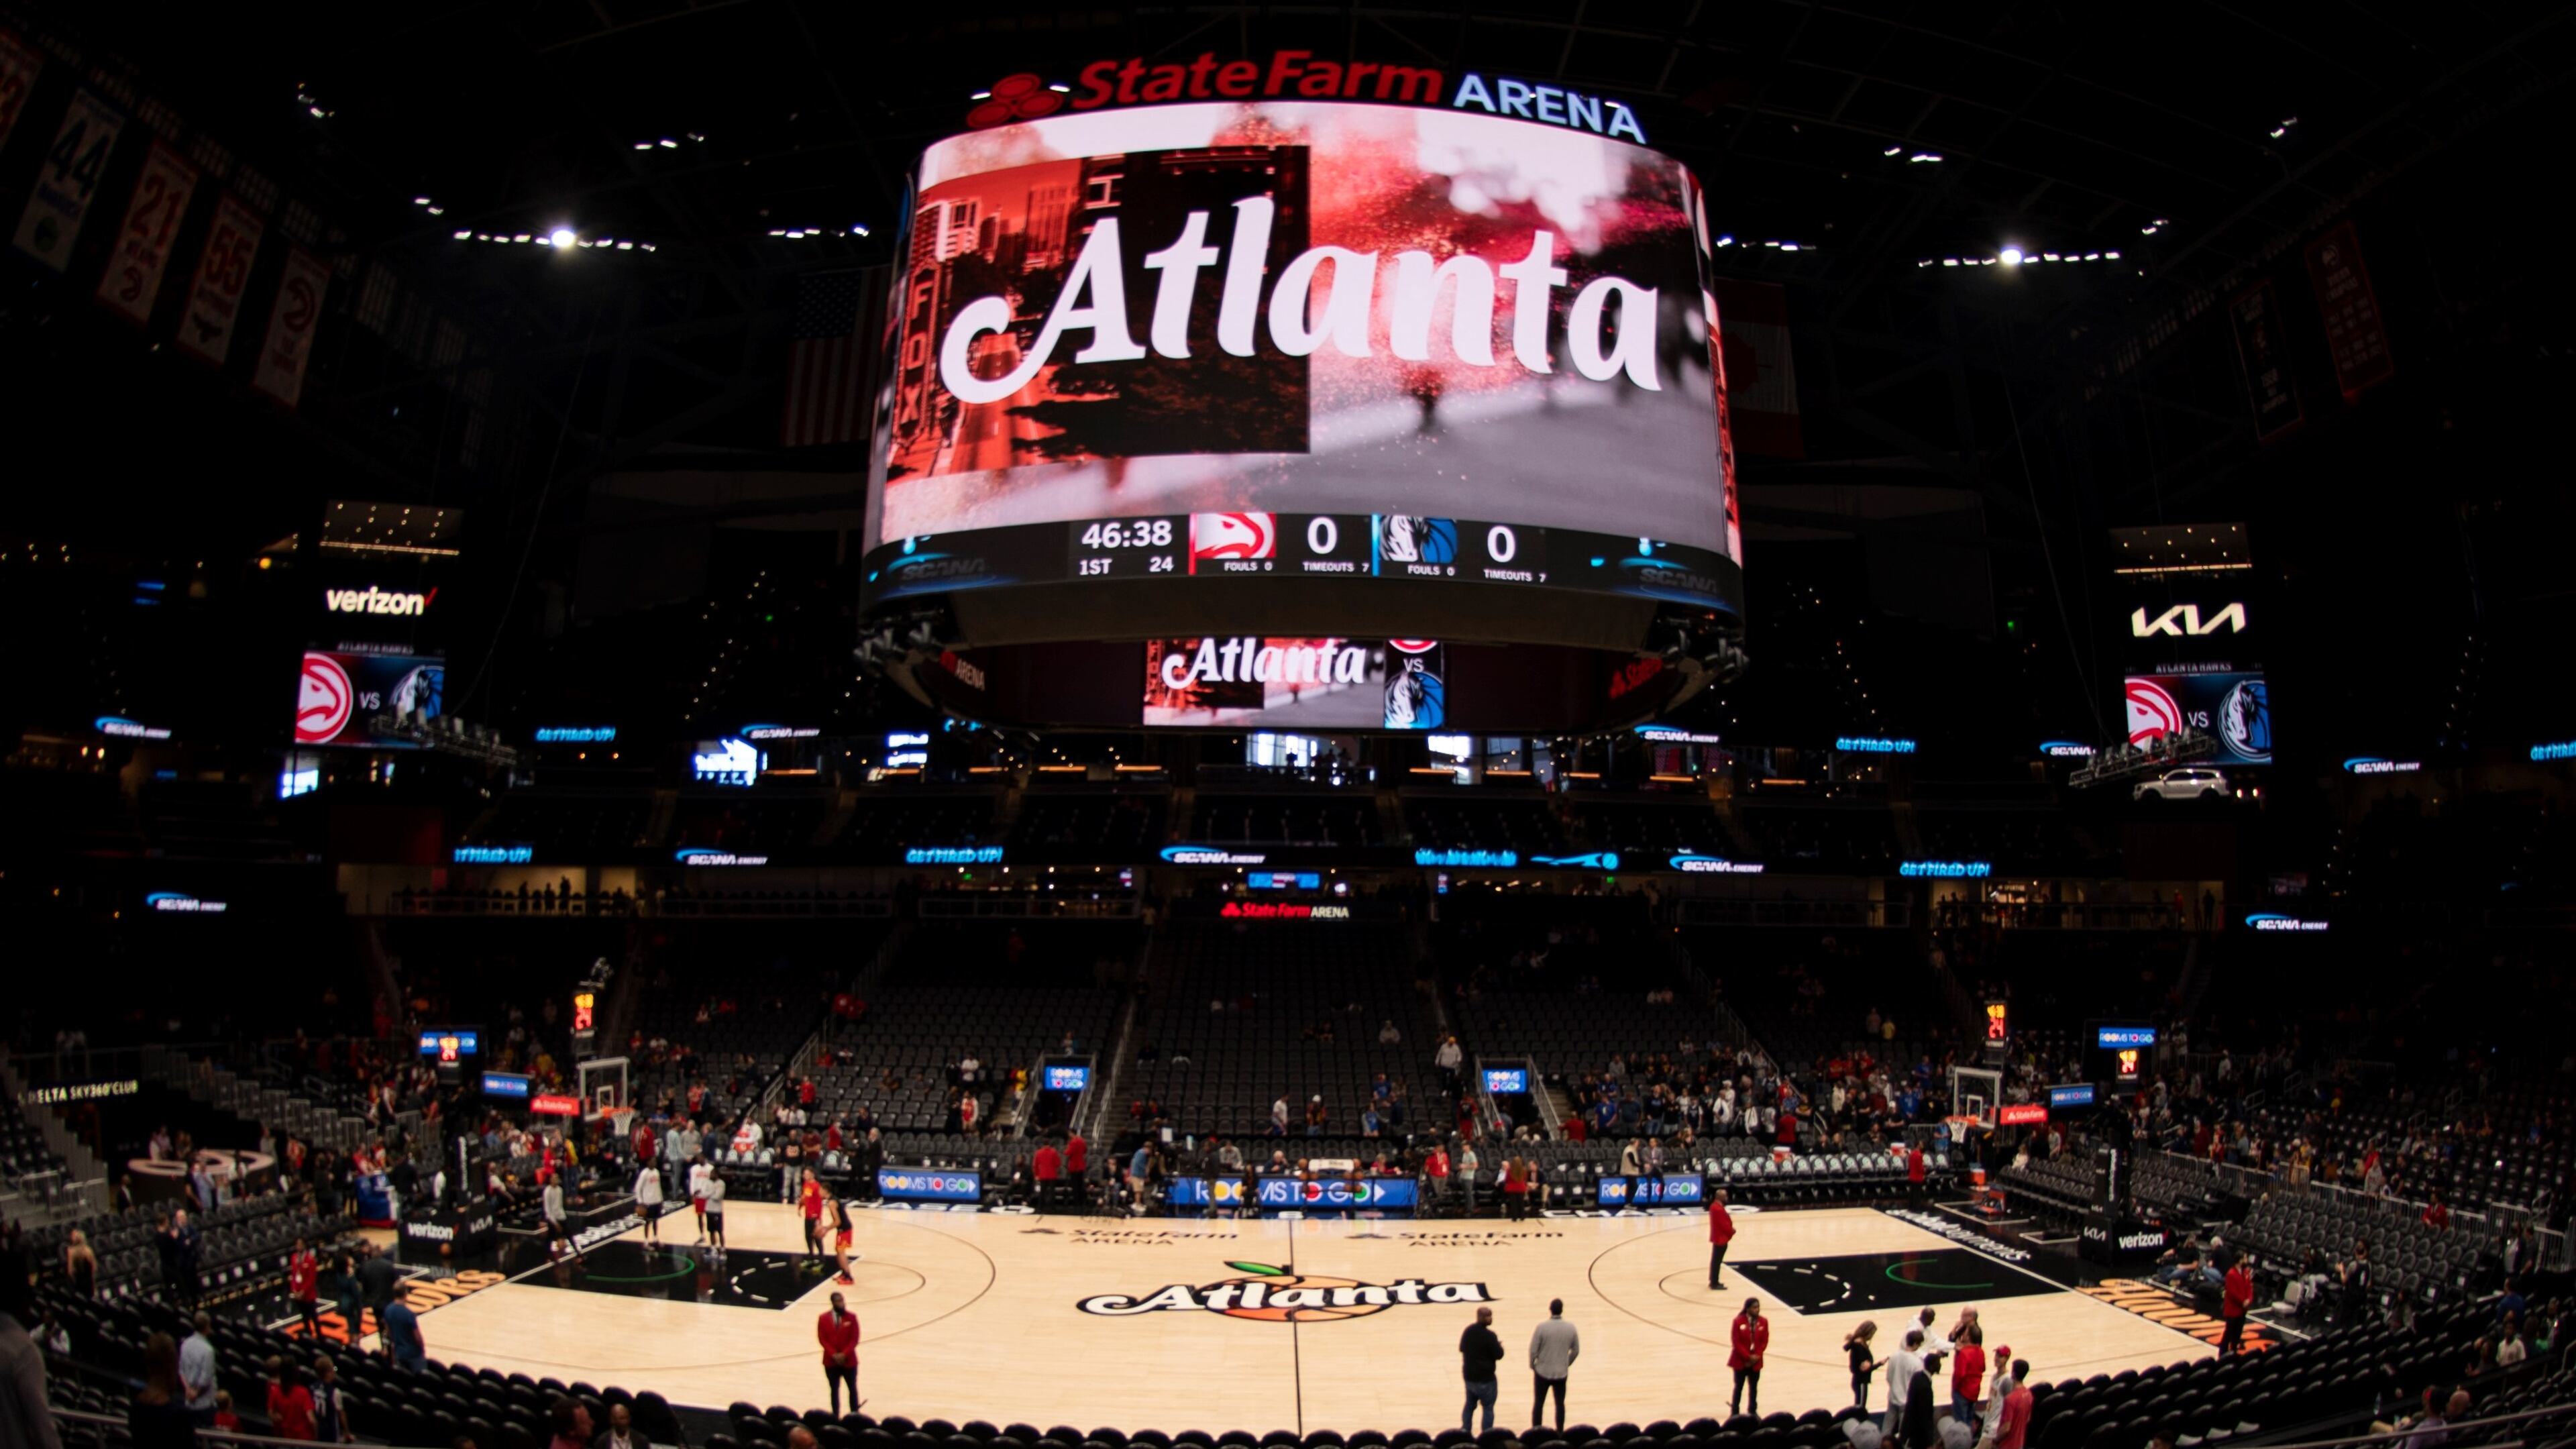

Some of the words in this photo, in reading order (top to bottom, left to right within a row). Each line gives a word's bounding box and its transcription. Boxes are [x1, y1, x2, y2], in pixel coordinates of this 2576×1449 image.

[1073, 52, 1258, 109] State
[1264, 50, 1444, 103] Farm
[1454, 73, 1648, 144] ARENA
[51, 119, 109, 197] 44
[130, 174, 182, 257] 21
[205, 223, 250, 296] 55
[940, 197, 1662, 403] Atlanta
[1081, 521, 1173, 549] 46:38
[1307, 517, 1338, 555] 0
[1487, 525, 1516, 563] 0
[1079, 558, 1112, 576] 1ST
[1149, 557, 1174, 573] 24
[1224, 561, 1257, 572] FOULS
[1303, 561, 1354, 573] TIMEOUTS
[1362, 563, 1370, 574] 7
[1407, 565, 1440, 576] FOULS
[1484, 569, 1532, 582] TIMEOUTS
[1539, 573, 1546, 583] 7
[327, 586, 425, 615] verizon
[2131, 602, 2246, 637] KIA
[1161, 638, 1366, 690] Atlanta
[1403, 658, 1424, 673] VS
[2155, 664, 2198, 674] ATLANTA
[2199, 662, 2232, 672] HAWKS
[359, 692, 381, 710] VS
[2188, 711, 2208, 728] VS
[594, 727, 616, 741] UP!
[751, 729, 792, 739] SCANA
[1645, 730, 1689, 742] SCANA
[1836, 739, 1861, 752] GET
[1860, 739, 1894, 753] FIRED
[1894, 740, 1915, 753] UP!
[2051, 745, 2091, 756] SCANA
[2530, 745, 2551, 761] GET
[2354, 761, 2394, 773] SCANA
[507, 846, 533, 863] UP!
[687, 854, 735, 865] SCANA
[906, 849, 938, 863] GET
[937, 848, 977, 863] FIRED
[977, 847, 1004, 863] UP!
[1173, 852, 1228, 864] SCANA
[1230, 855, 1266, 864] ENERGY
[1682, 861, 1731, 873] SCANA
[1732, 864, 1764, 873] ENERGY
[1900, 861, 1928, 876] GET
[1927, 862, 1965, 877] FIRED
[1966, 862, 1990, 877] UP!
[1242, 902, 1276, 918] State
[1277, 902, 1311, 918] Farm
[1310, 906, 1349, 918] ARENA
[2256, 919, 2300, 930] SCANA
[112, 1079, 138, 1095] CLUB
[879, 1175, 926, 1191] ROOMS
[927, 1177, 945, 1191] TO
[945, 1177, 969, 1193] GO
[1290, 1181, 1324, 1202] TO
[1327, 1181, 1372, 1203] GO
[1669, 1181, 1690, 1195] GO
[407, 1222, 453, 1240] verizon
[1070, 1229, 1152, 1238] State
[1157, 1230, 1238, 1239] Farm
[2084, 1226, 2106, 1242] KIA
[2118, 1232, 2163, 1250] verizon
[1076, 1278, 1502, 1317] Atlanta
